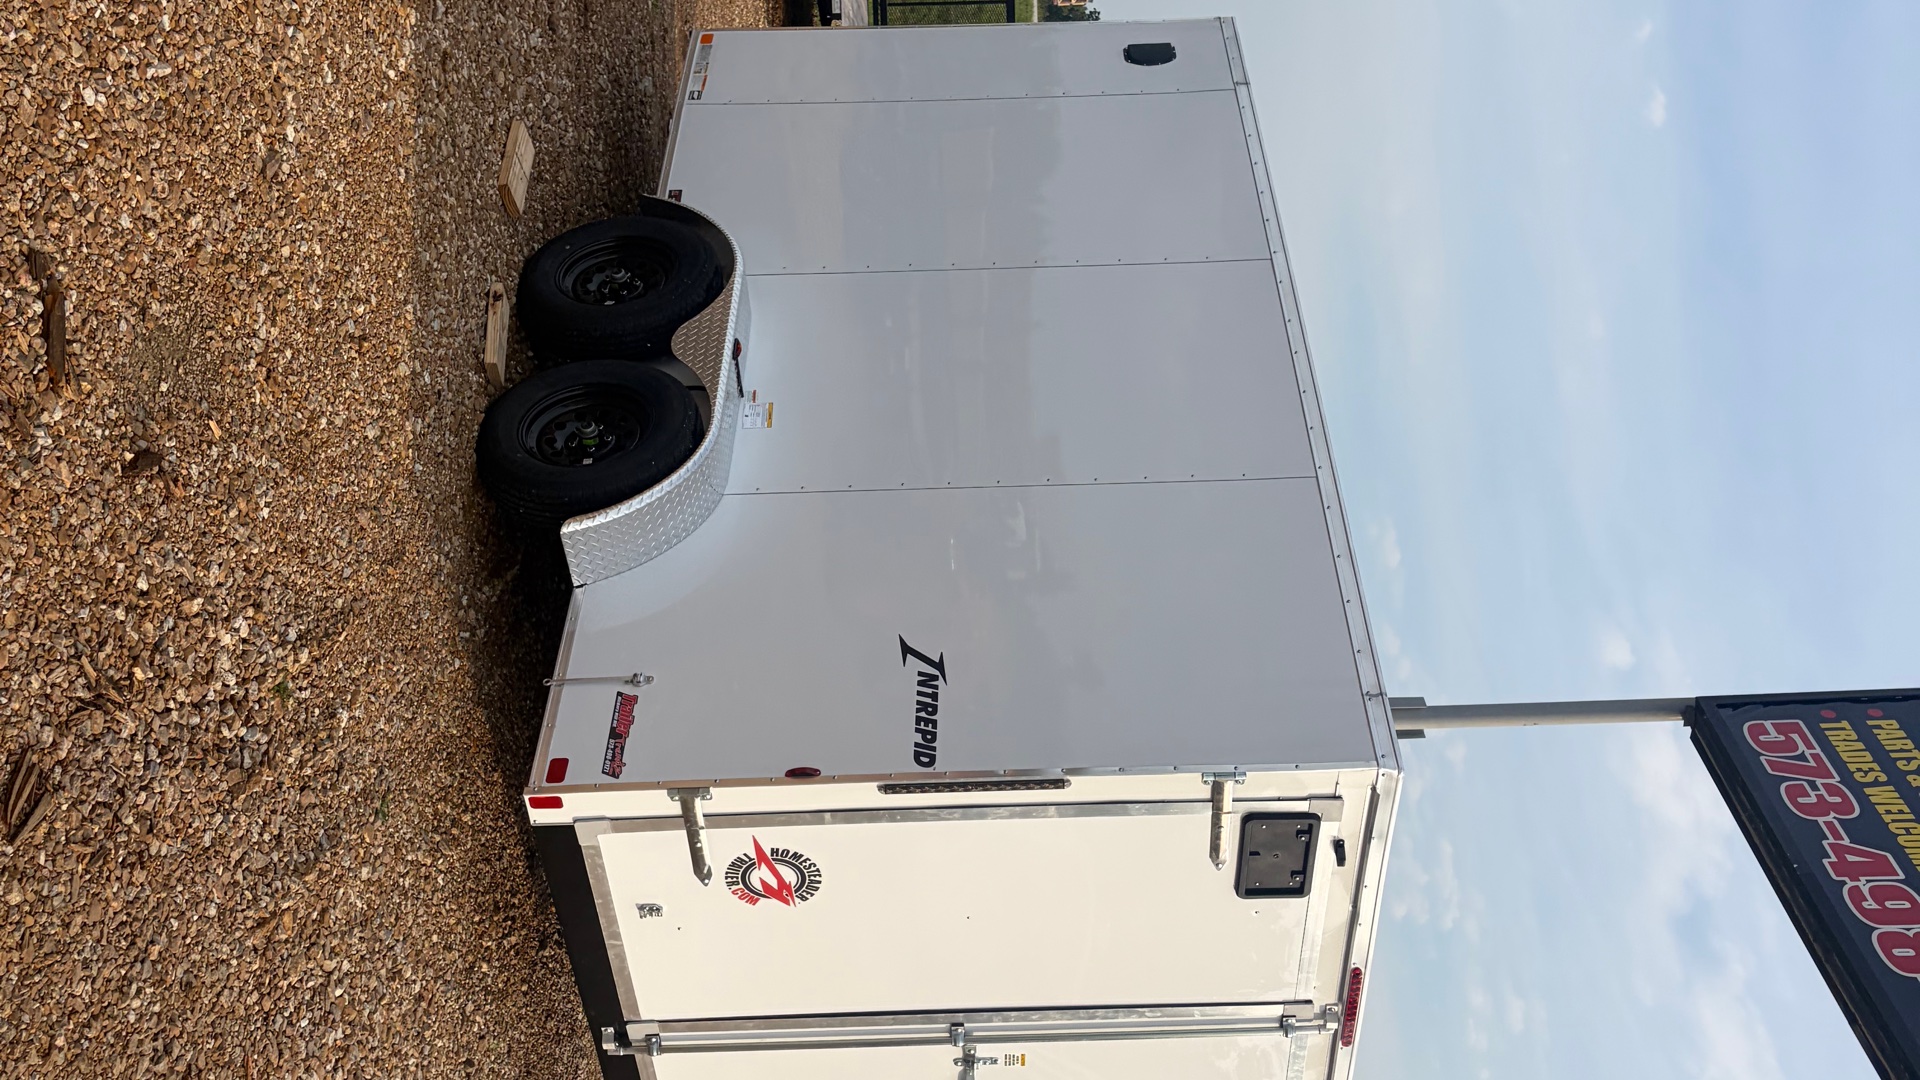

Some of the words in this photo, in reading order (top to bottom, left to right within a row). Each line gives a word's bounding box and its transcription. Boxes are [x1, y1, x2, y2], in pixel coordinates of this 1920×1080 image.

[899, 633, 948, 769] INTREPID
[1819, 720, 1888, 783] TRADES
[1866, 719, 1920, 771] PARTS
[724, 852, 761, 907] TRAILER.COM
[770, 847, 822, 902] HOMESTEADER
